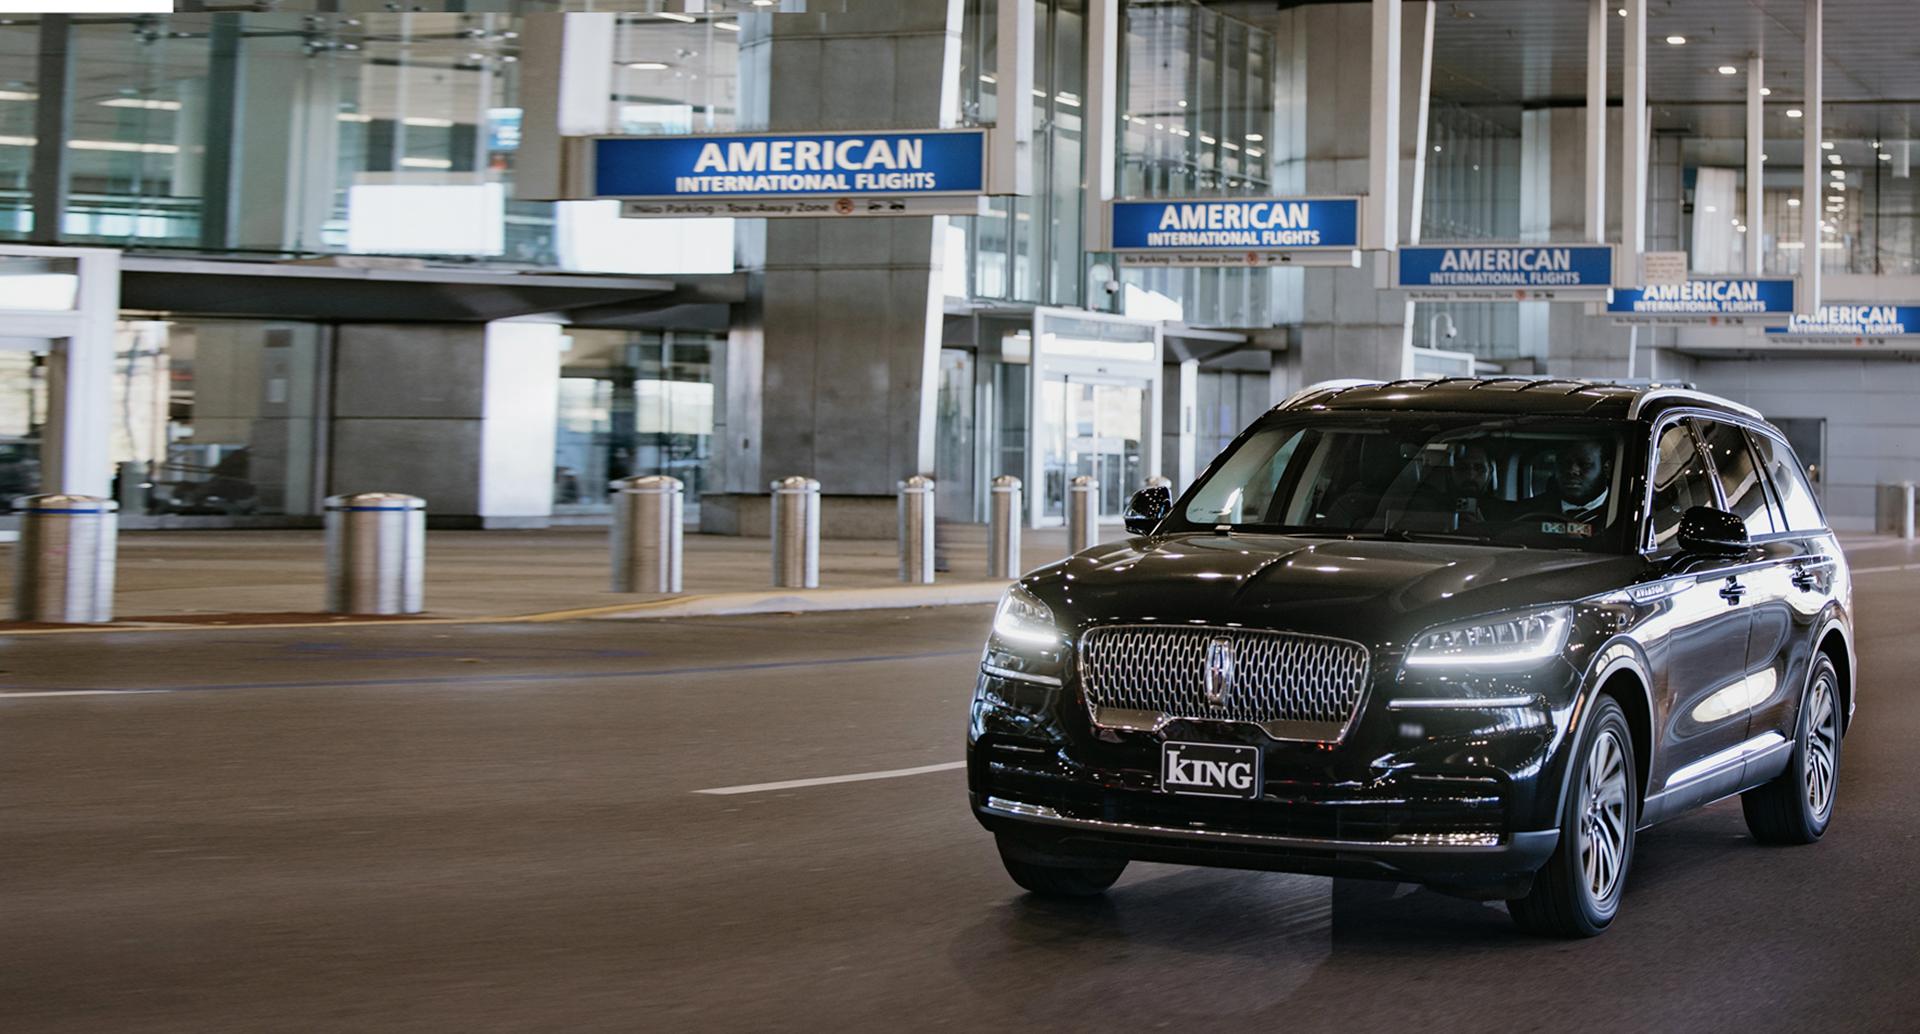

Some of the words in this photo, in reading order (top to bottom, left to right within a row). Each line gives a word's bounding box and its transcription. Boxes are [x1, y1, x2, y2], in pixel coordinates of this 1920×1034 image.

[693, 138, 923, 173] AMERICAN
[675, 173, 850, 193] INTERNATIONAL
[855, 172, 936, 190] FLIGHTS
[666, 204, 715, 216] Parking
[727, 202, 793, 214] Tow-Away
[797, 202, 830, 213] Zone
[1159, 203, 1310, 230] AMERICAN
[1147, 231, 1260, 246] INTERNATIONAL
[1262, 230, 1321, 245] FLIGHTS
[1440, 249, 1571, 271] AMERICAN
[1430, 272, 1526, 285] INTERNATIONAL
[1529, 271, 1580, 284] FLIGHTS
[1642, 281, 1758, 301] AMERICAN
[1633, 301, 1720, 312] INTERNATIONAL
[1721, 300, 1767, 312] FLIGHTS
